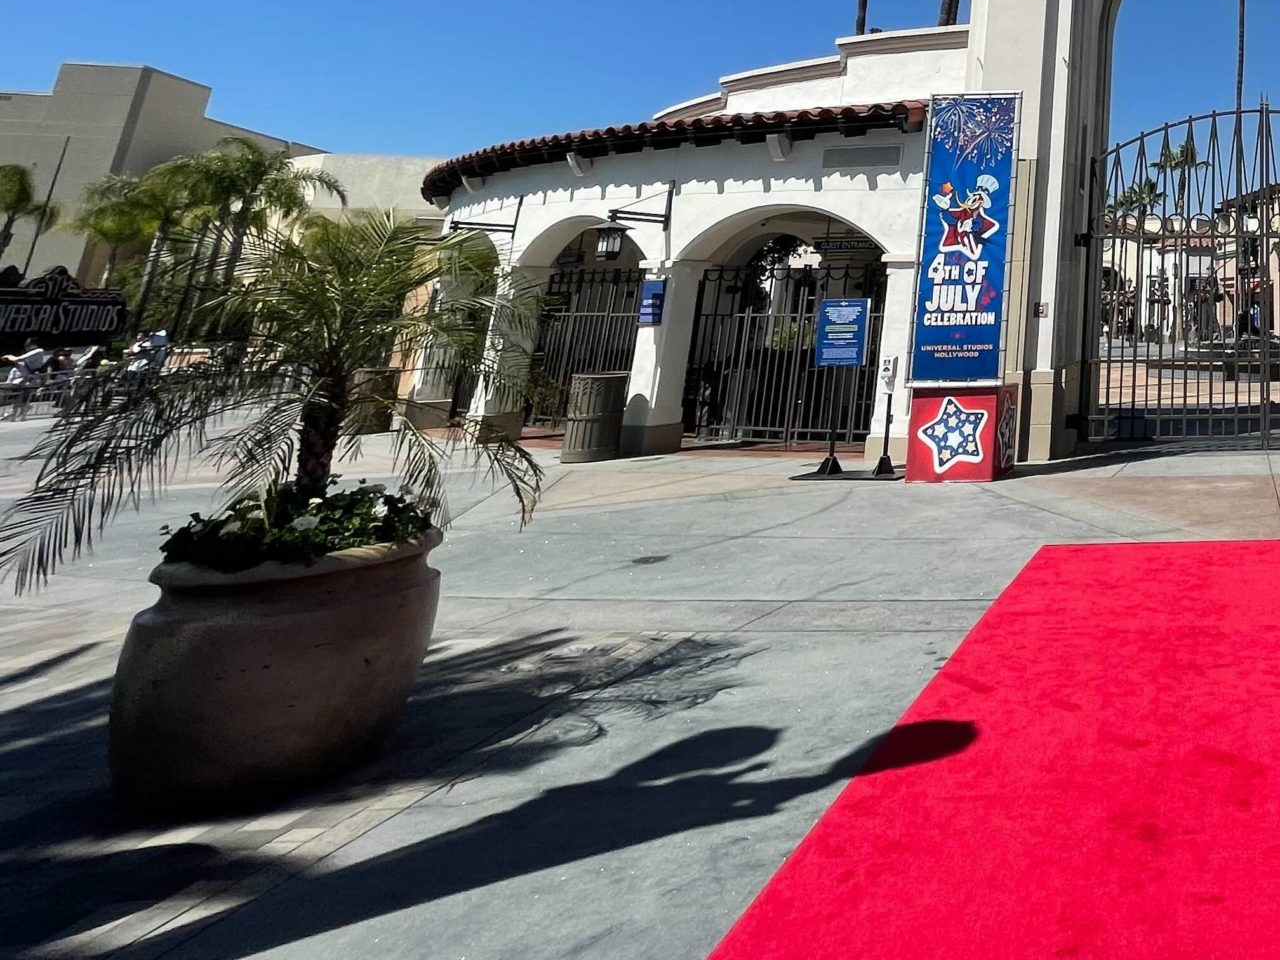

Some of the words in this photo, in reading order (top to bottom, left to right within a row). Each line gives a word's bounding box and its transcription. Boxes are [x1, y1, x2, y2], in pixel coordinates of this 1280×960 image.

[927, 253, 960, 284] 4TH
[963, 260, 989, 284] OF
[925, 284, 982, 312] JULY
[0, 304, 57, 332] VERSAL
[52, 301, 122, 334] STUDIOS
[923, 312, 996, 326] CELEBRATION
[921, 344, 961, 352] UNIVERSAL
